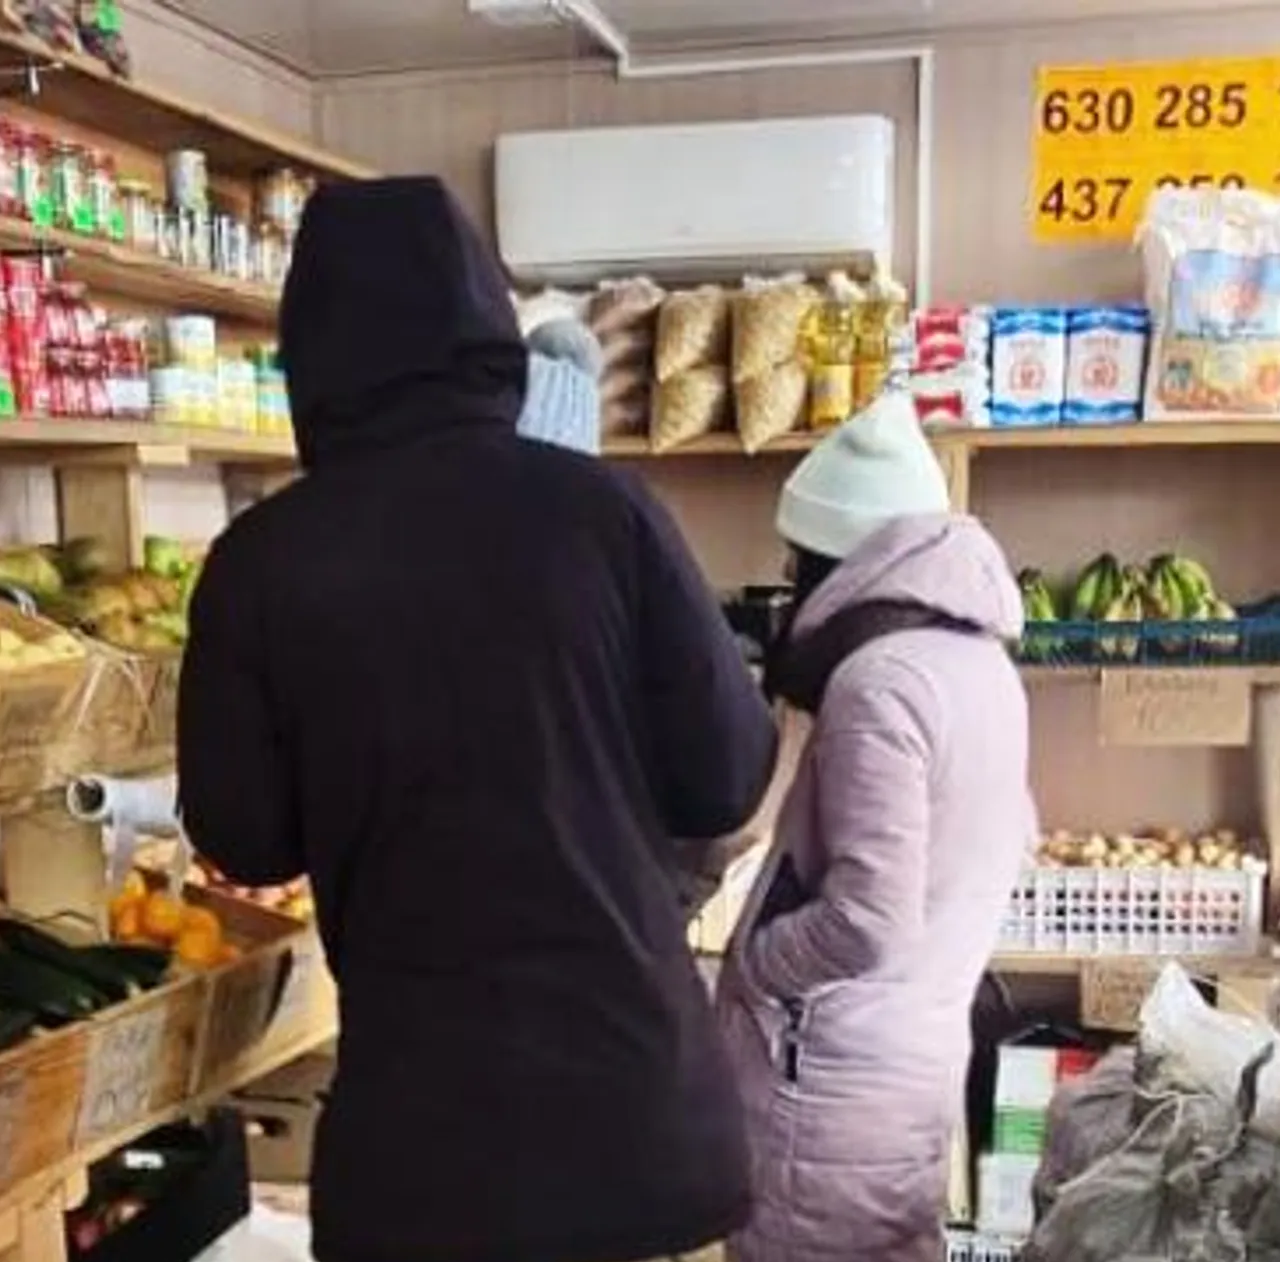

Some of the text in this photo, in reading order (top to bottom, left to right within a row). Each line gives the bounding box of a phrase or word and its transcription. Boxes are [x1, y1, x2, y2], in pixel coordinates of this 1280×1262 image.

[1041, 89, 1134, 134] 630
[1154, 83, 1247, 129] 285
[1039, 178, 1133, 222] 437
